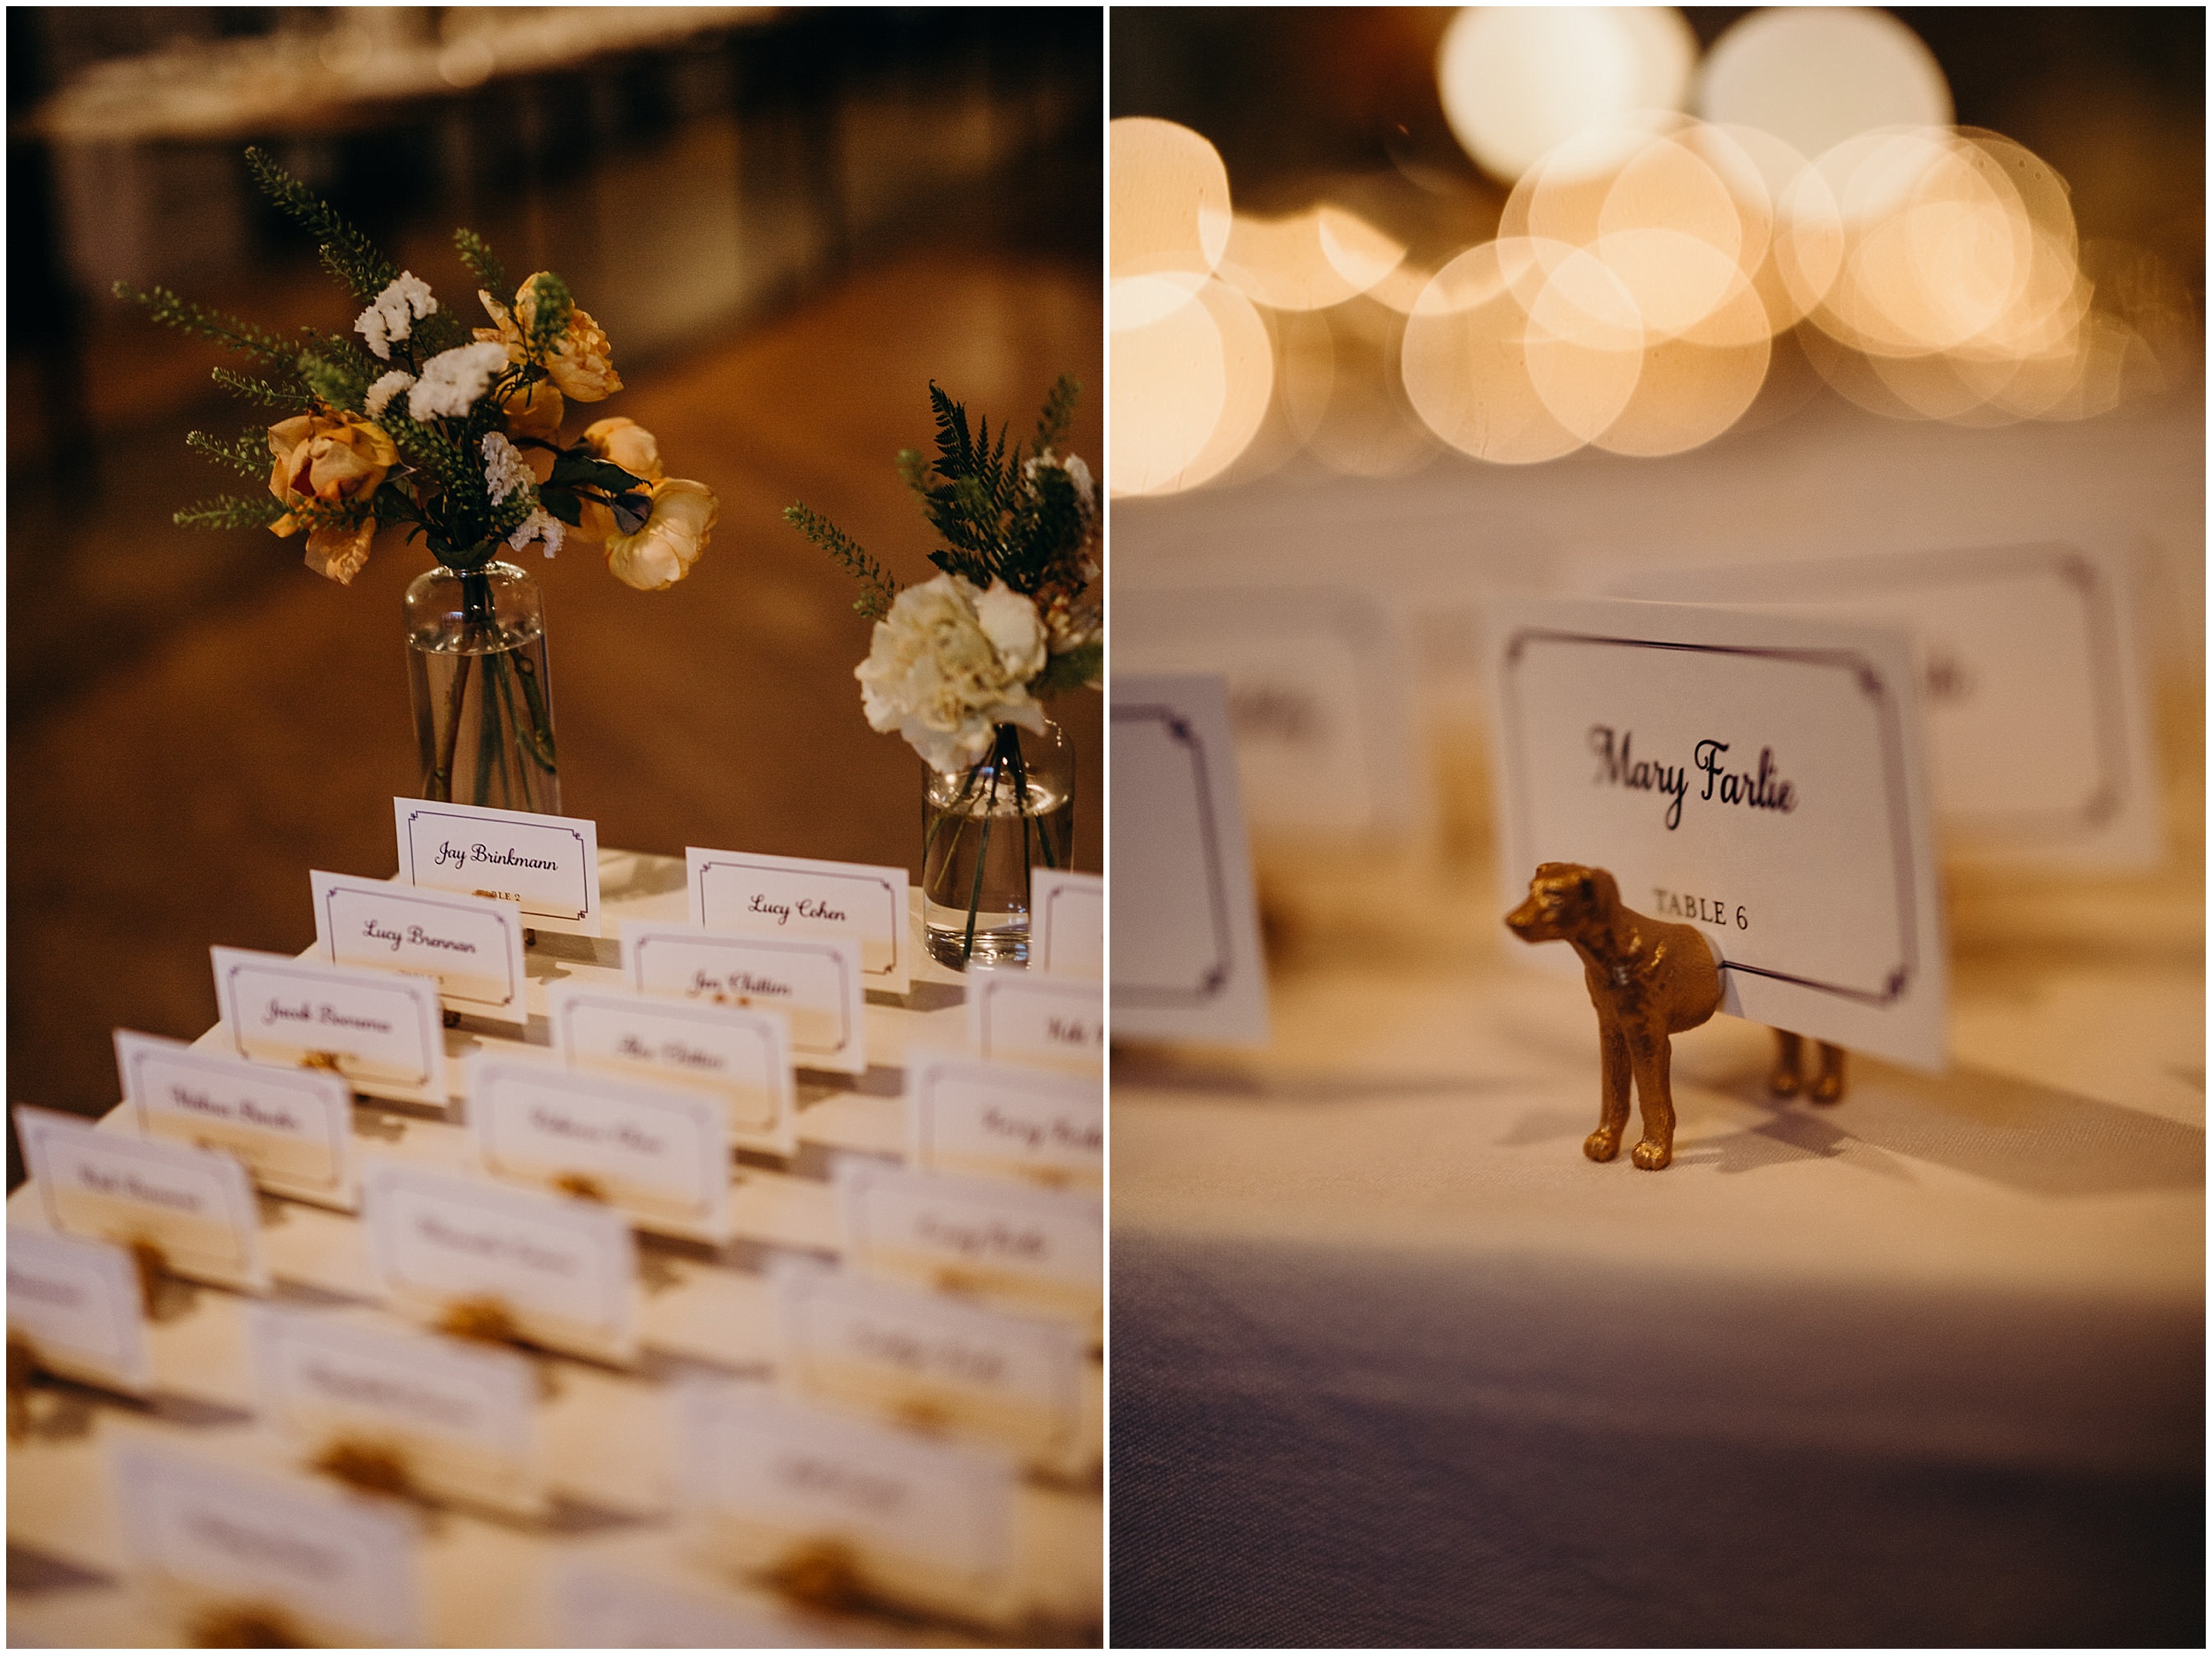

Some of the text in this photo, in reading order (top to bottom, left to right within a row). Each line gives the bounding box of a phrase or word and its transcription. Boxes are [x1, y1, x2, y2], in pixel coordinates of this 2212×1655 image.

[1587, 724, 1798, 830] Mary Farlie
[434, 841, 558, 871] Jay Brinkmann
[748, 894, 846, 926] Lucy Cohen
[1653, 888, 1748, 929] TABLE 6
[362, 920, 477, 953] Lucy Brennan
